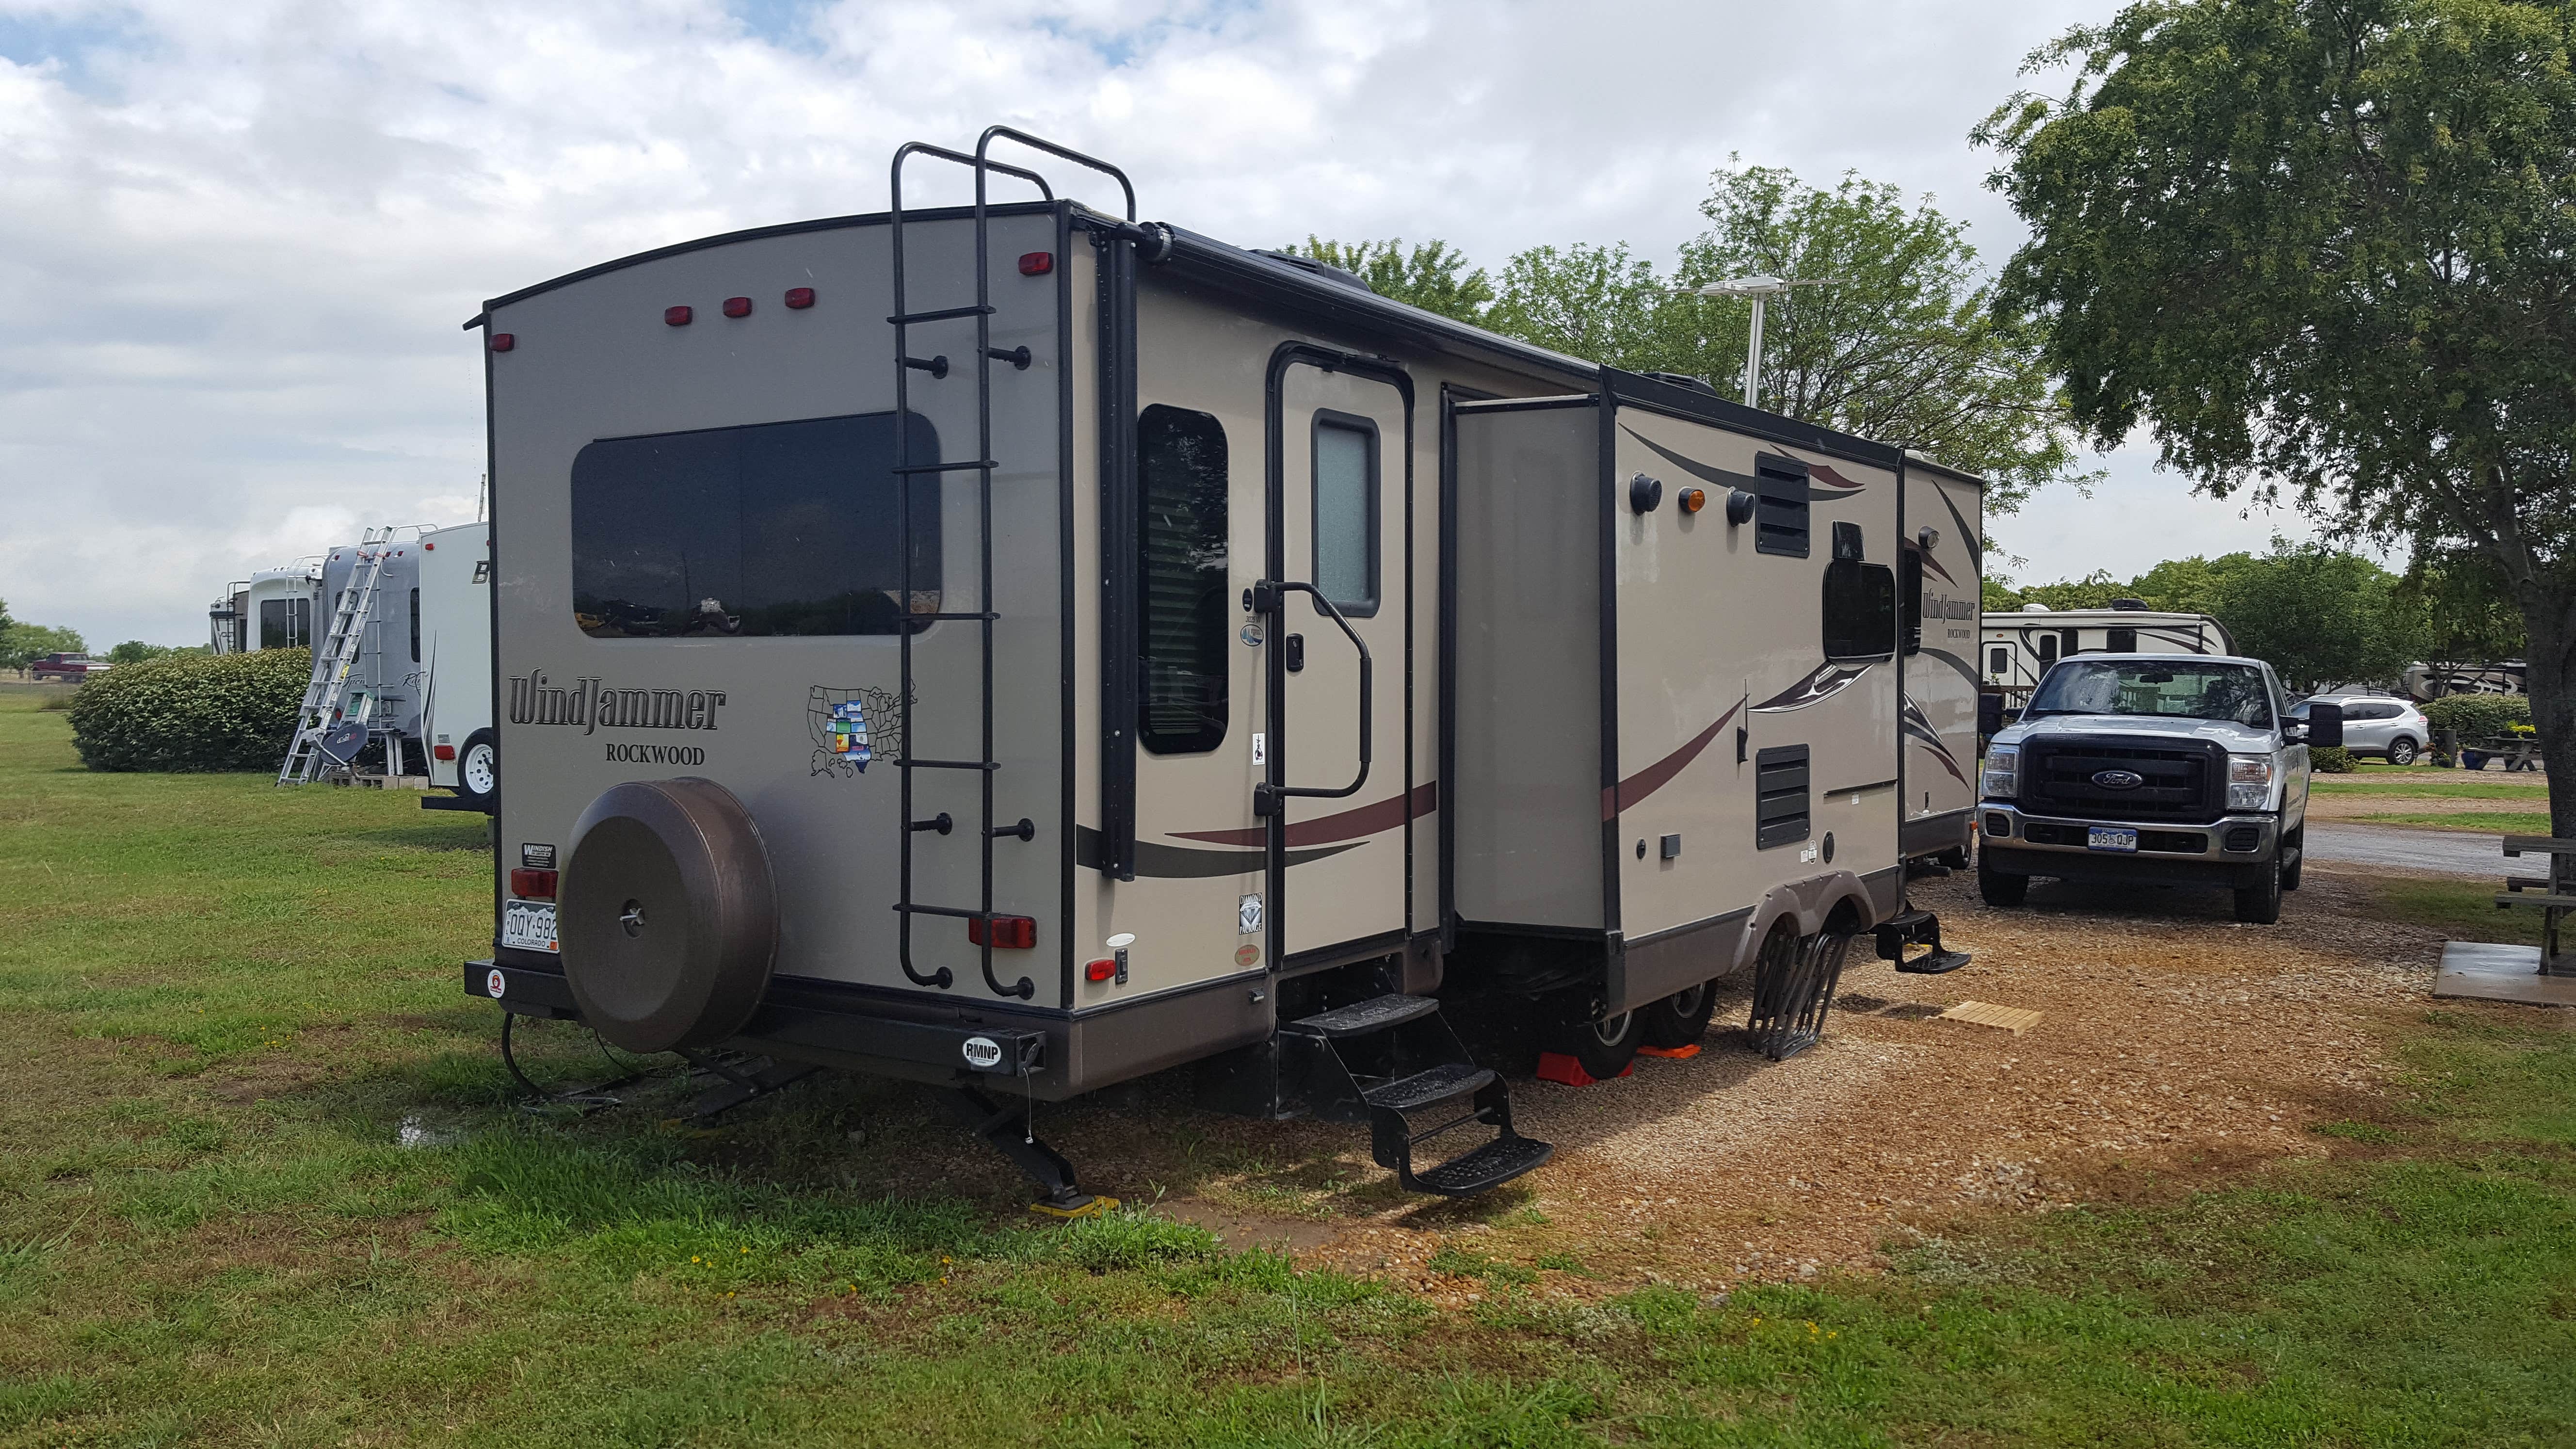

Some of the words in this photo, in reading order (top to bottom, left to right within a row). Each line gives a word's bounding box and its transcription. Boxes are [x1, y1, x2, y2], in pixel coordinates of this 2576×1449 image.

[1922, 587, 1975, 625] WindJammer
[1948, 628, 1970, 639] ROCKWOOD
[509, 667, 726, 736] WindJammer
[337, 733, 350, 744] dish
[606, 743, 705, 766] ROCKWOOD
[2103, 773, 2130, 785] Ford
[2091, 833, 2108, 844] 305
[524, 844, 553, 855] WINDISH
[1240, 893, 1262, 904] DIAMOND
[1240, 923, 1262, 935] PACKAGE
[517, 937, 546, 947] COLORADO
[966, 1043, 998, 1060] RMNP
